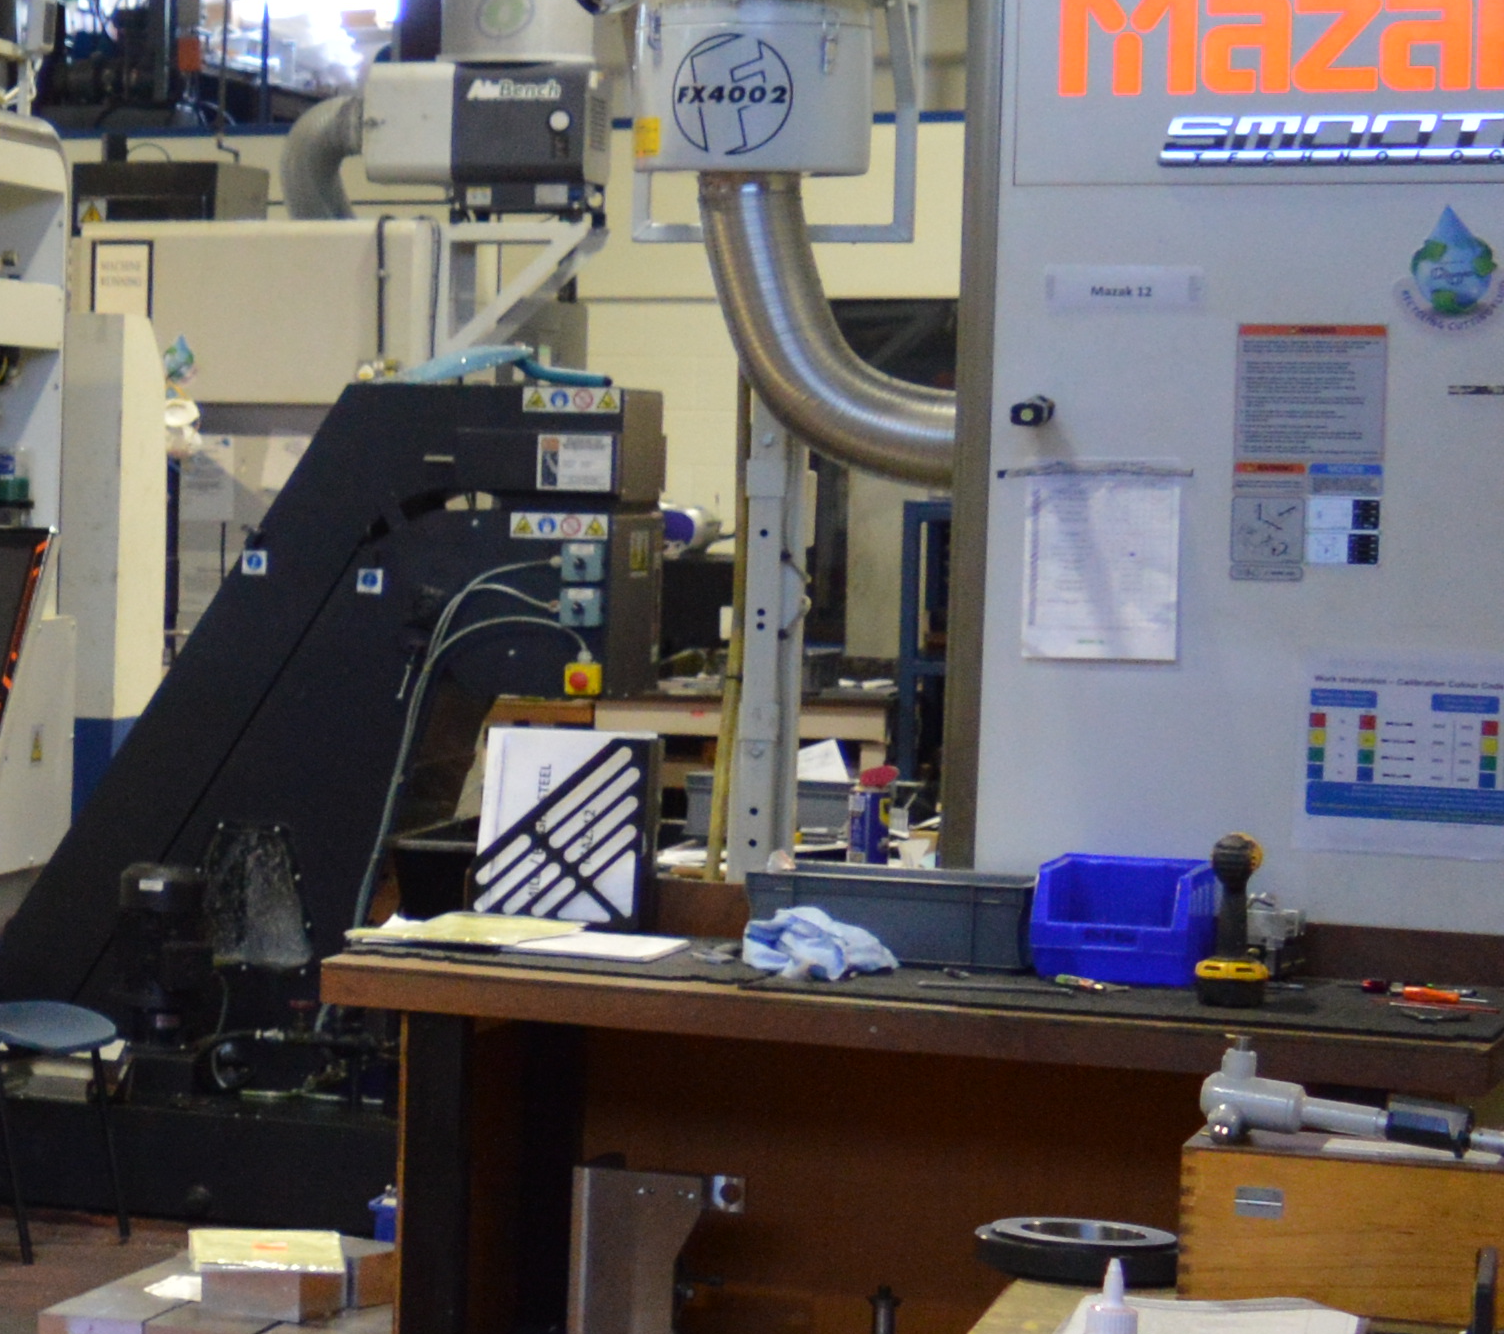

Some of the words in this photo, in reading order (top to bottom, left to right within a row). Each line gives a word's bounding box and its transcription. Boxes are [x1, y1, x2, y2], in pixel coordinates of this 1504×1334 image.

[677, 86, 787, 104] FX4002
[1163, 114, 1504, 151] SMOOT
[1091, 285, 1132, 297] Mazak
[1138, 286, 1152, 297] 12
[1396, 678, 1445, 687] Calibration
[1448, 680, 1478, 689] Colour
